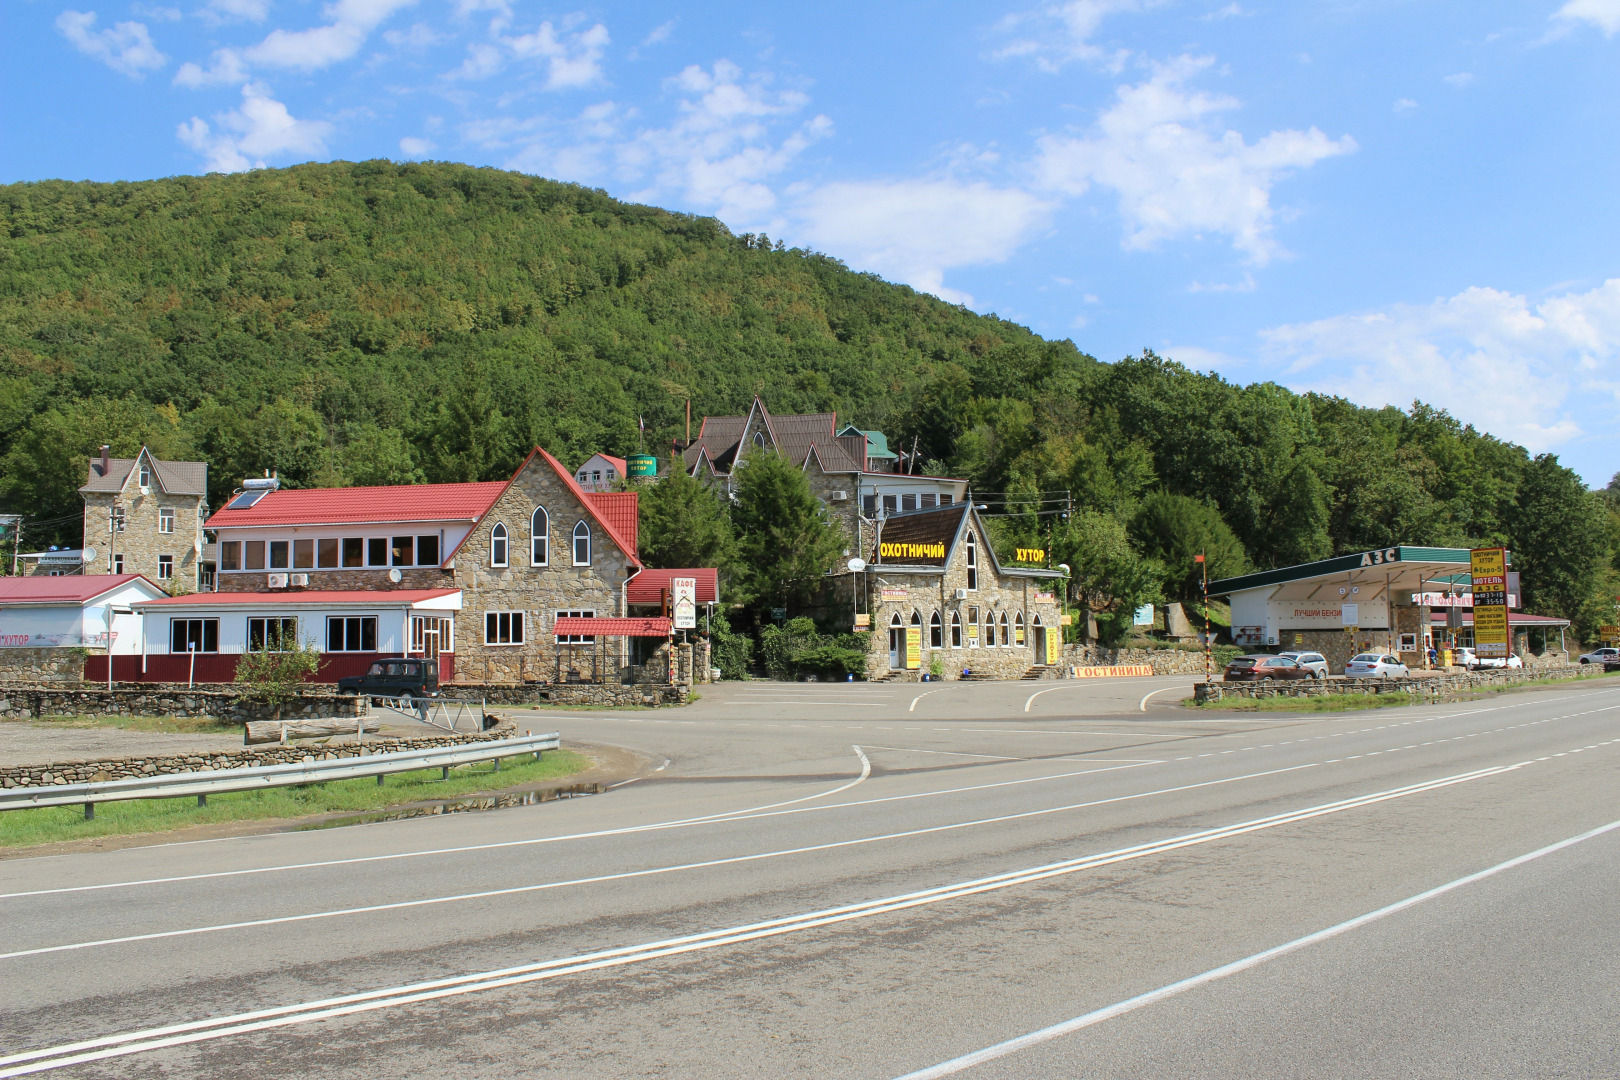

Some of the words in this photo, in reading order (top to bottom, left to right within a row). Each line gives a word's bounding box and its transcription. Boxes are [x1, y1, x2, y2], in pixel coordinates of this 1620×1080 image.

[880, 541, 945, 558] ОХОТНИЧИЙ
[1016, 548, 1045, 562] ХУТОР
[1360, 549, 1395, 567] АЗС
[676, 580, 694, 588] КАФЕ
[1473, 577, 1503, 585] МОТЕЛЬ
[3, 634, 29, 646] ХУТОР
